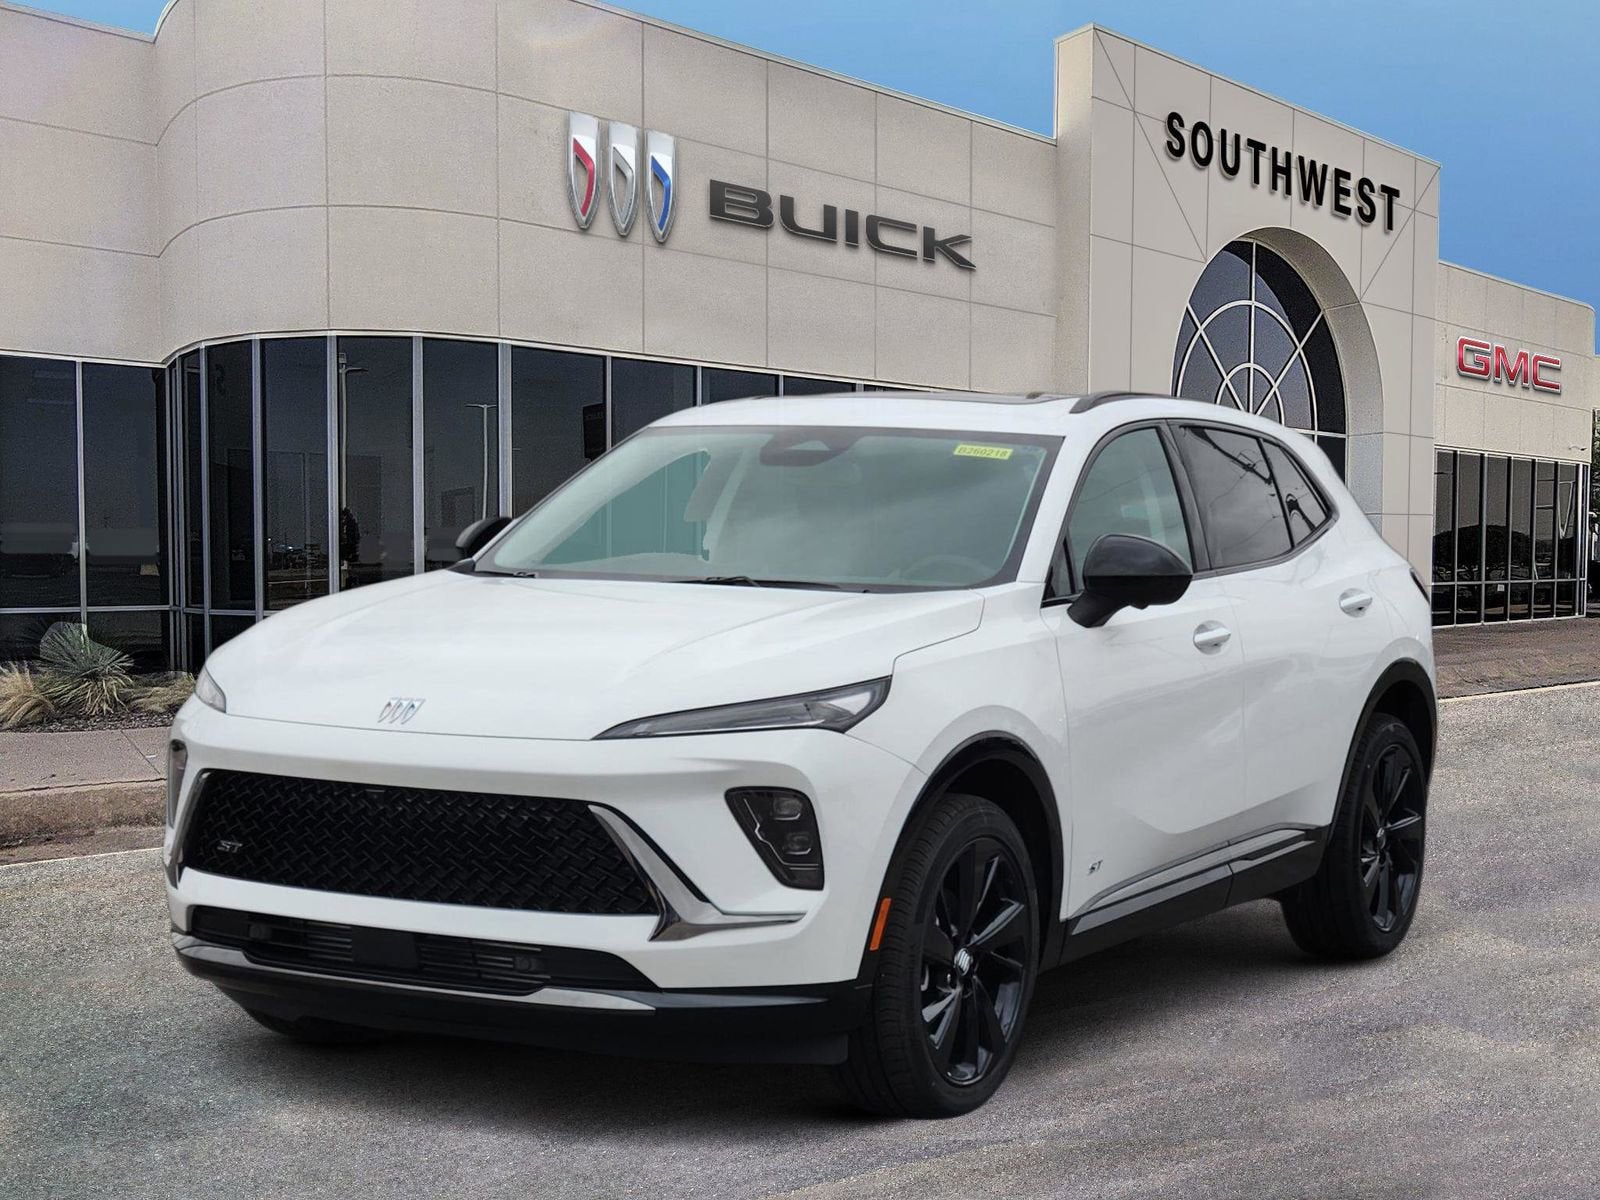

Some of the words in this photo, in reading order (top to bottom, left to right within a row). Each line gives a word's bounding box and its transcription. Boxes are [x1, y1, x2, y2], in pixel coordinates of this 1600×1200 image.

[1166, 111, 1400, 231] SOUTHWEST
[709, 179, 976, 270] BUICK
[1457, 336, 1561, 393] GMC
[217, 840, 242, 853] ST
